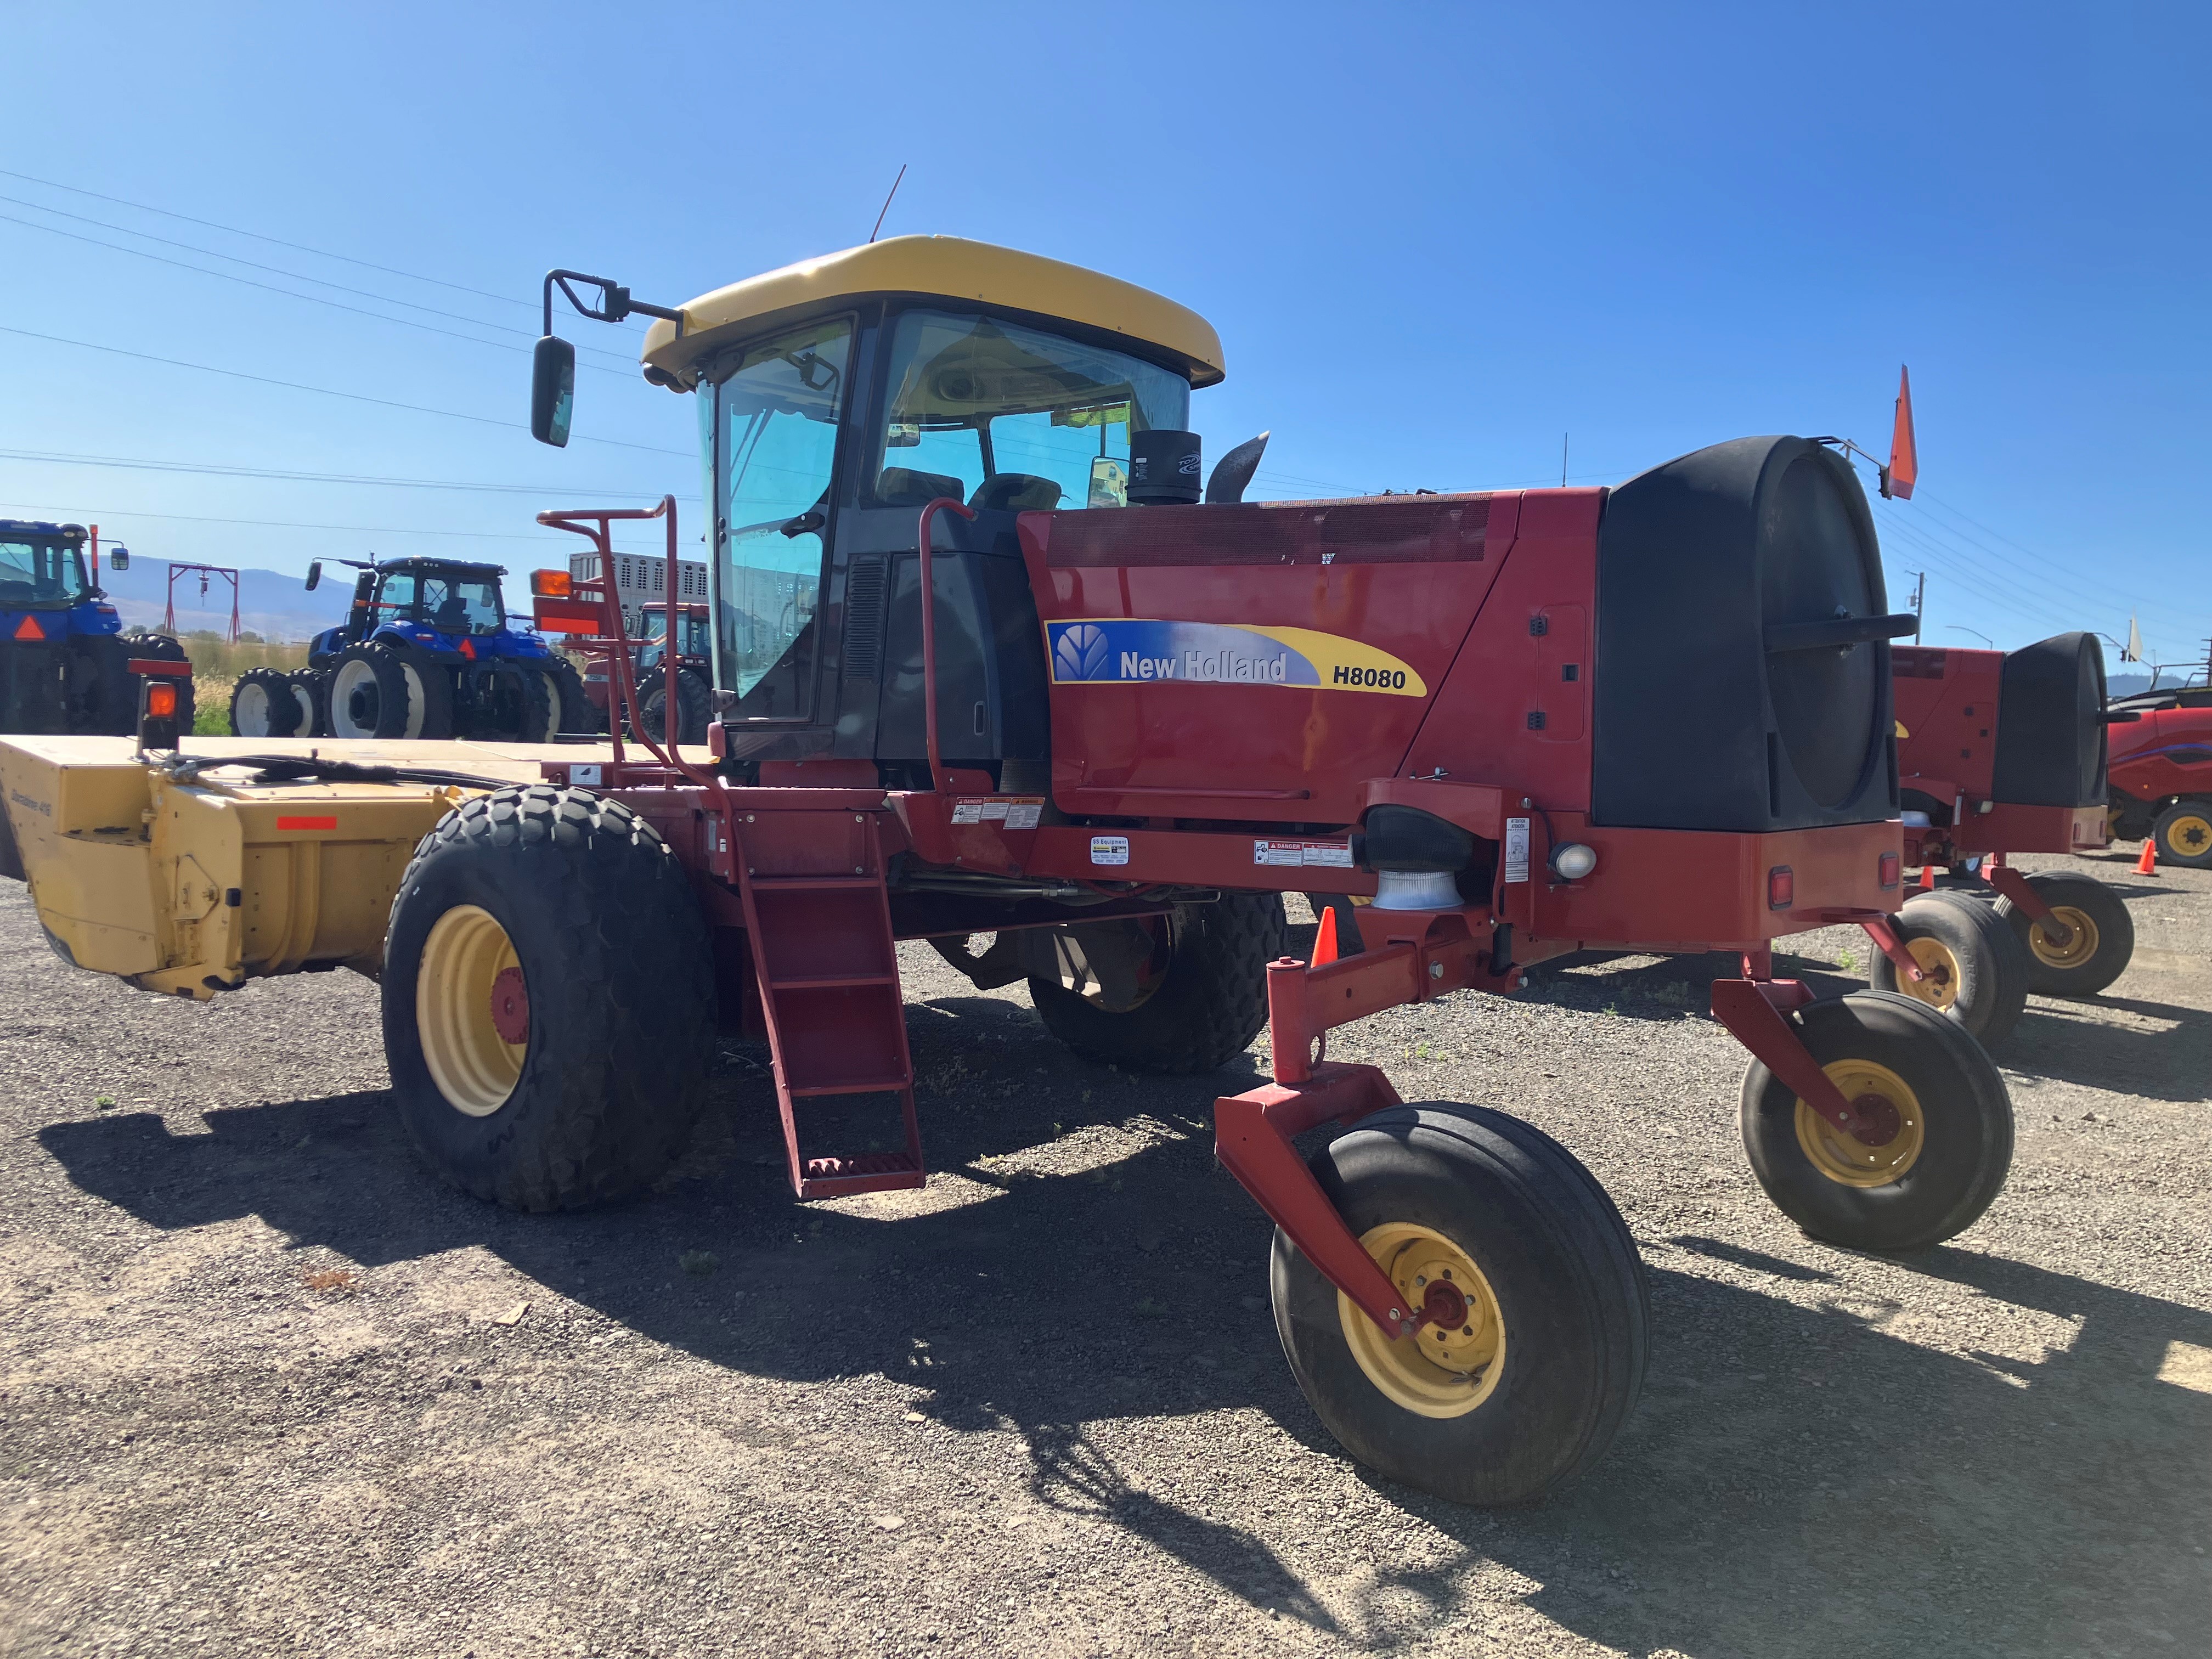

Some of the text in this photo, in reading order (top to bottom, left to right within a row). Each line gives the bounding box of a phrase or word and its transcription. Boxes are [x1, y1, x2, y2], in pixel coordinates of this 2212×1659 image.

[1178, 458, 1196, 466] TOP
[1121, 651, 1286, 681] New Holland
[1333, 665, 1406, 690] H8080
